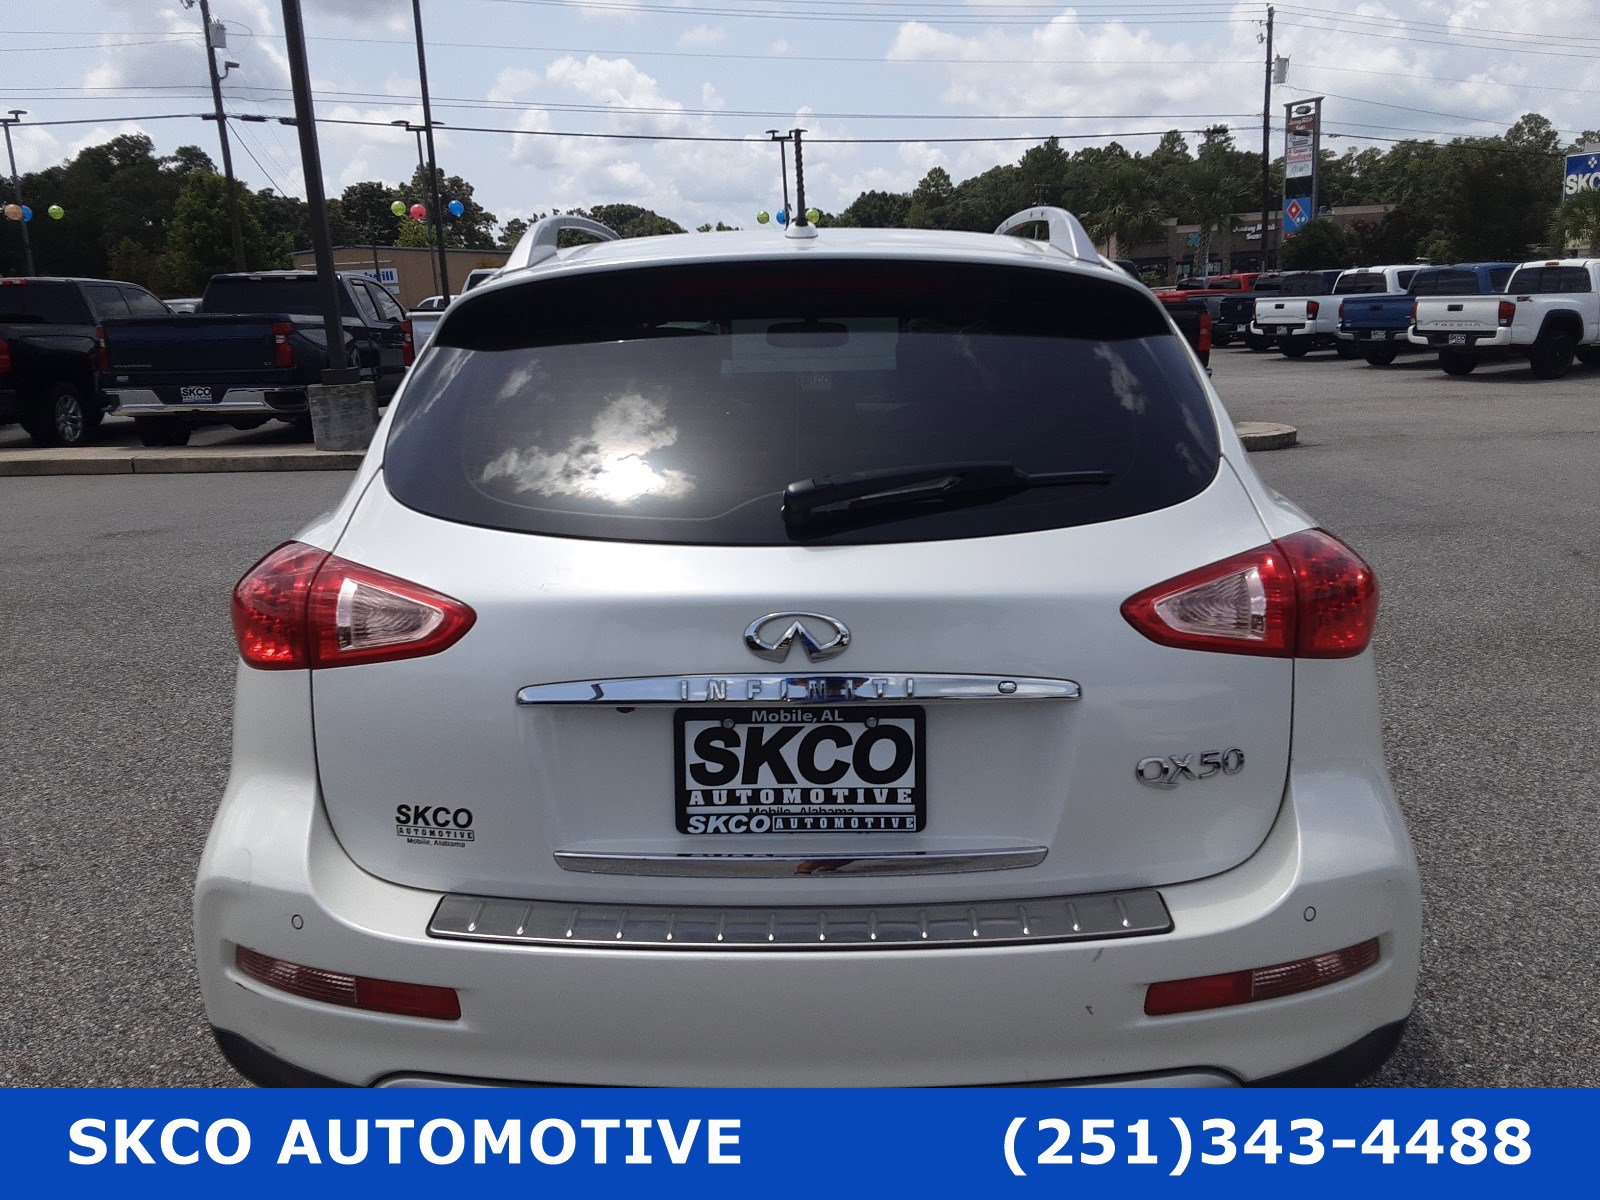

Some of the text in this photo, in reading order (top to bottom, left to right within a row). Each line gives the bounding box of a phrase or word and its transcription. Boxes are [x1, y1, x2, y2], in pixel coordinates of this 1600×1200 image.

[182, 387, 211, 397] SKCO
[680, 678, 914, 700] INFINITI
[751, 710, 844, 723] Mobile, AL
[689, 725, 913, 786] SKCO
[1135, 747, 1245, 790] QX50
[689, 788, 913, 806] AUTOMOTIVE
[395, 804, 473, 828] SKCO
[687, 815, 770, 834] SKCO
[775, 817, 915, 830] AUTOMOTIVE
[398, 827, 474, 839] AUTOMOTIVE
[434, 840, 466, 848] Alabama
